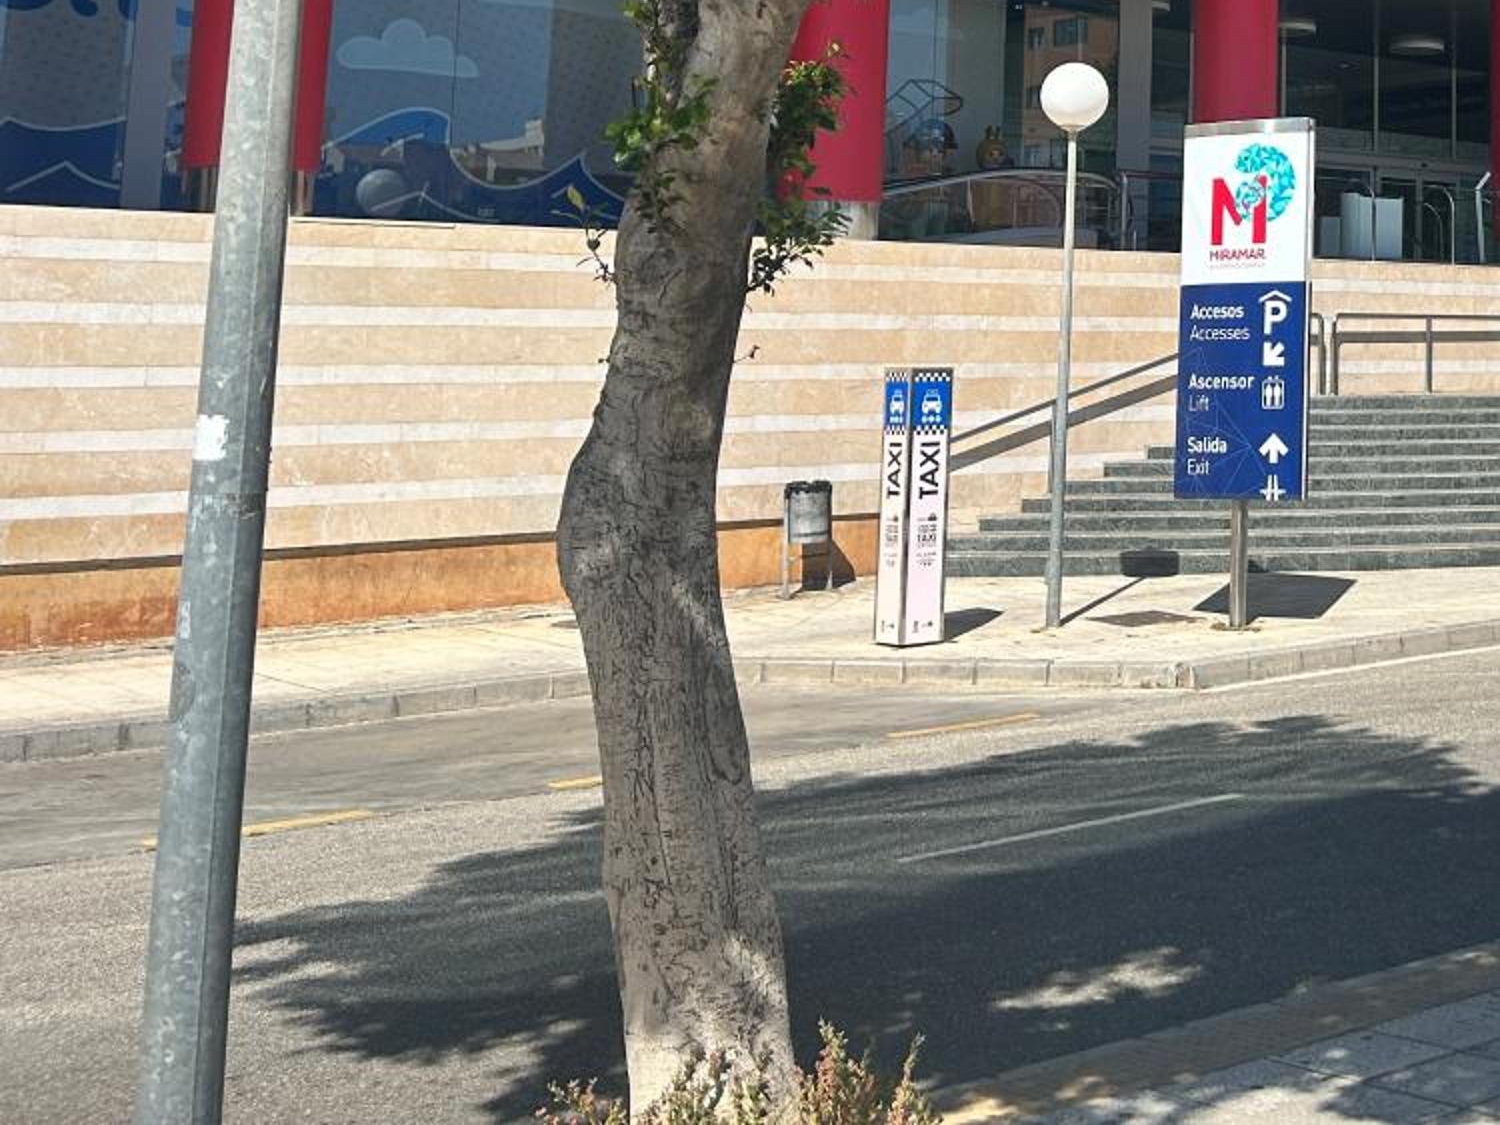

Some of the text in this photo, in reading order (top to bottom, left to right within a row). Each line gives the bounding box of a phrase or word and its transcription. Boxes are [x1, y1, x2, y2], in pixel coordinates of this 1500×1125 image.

[1209, 248, 1266, 262] MIRAMAR
[1190, 304, 1244, 320] Accesos
[1190, 325, 1250, 341] Accesses
[1188, 374, 1255, 390] Ascensor
[1189, 395, 1209, 411] Lift
[1187, 436, 1227, 453] Salida
[886, 442, 903, 499] TAXI
[918, 441, 940, 499] TAXI
[1187, 460, 1210, 475] Exit
